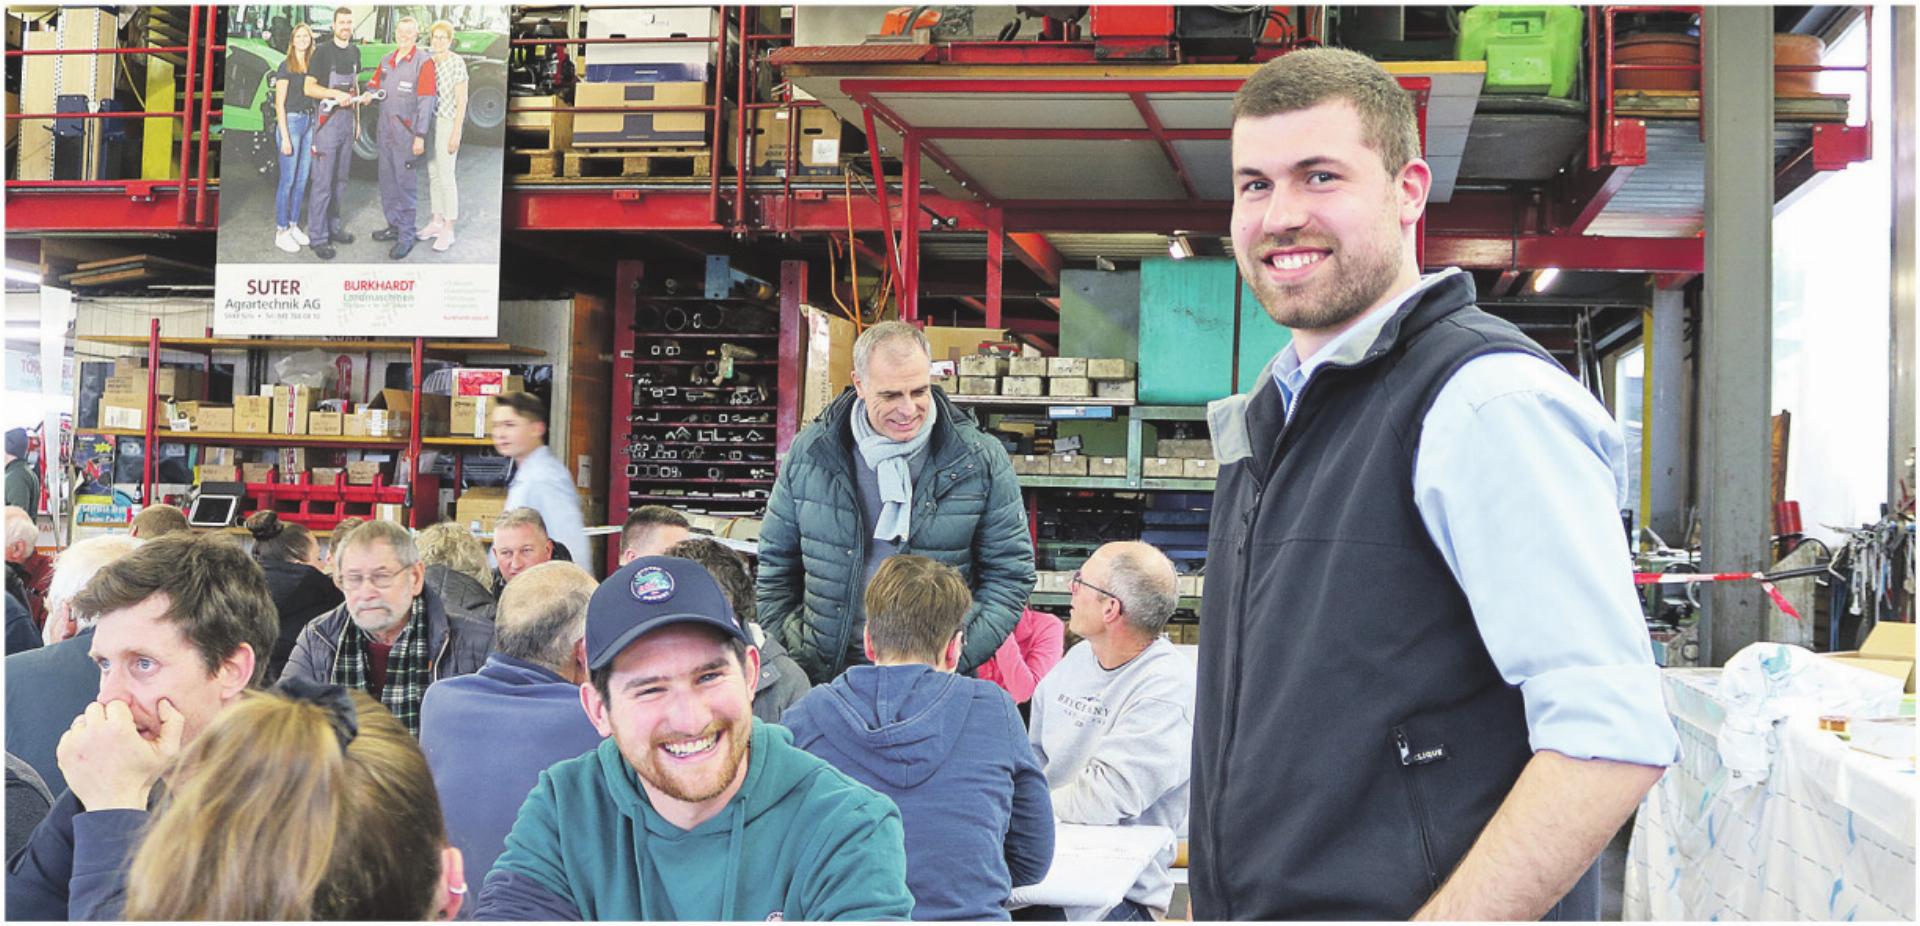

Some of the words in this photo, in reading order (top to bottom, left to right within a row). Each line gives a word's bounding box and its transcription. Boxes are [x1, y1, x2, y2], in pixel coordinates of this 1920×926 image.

[247, 279, 301, 295] SUTER
[343, 280, 416, 292] BURKHARDT
[343, 293, 415, 303] Landmaschinen
[225, 298, 300, 312] Agrartechnik
[303, 299, 321, 310] AG
[1413, 748, 1443, 761] CLIQUE
